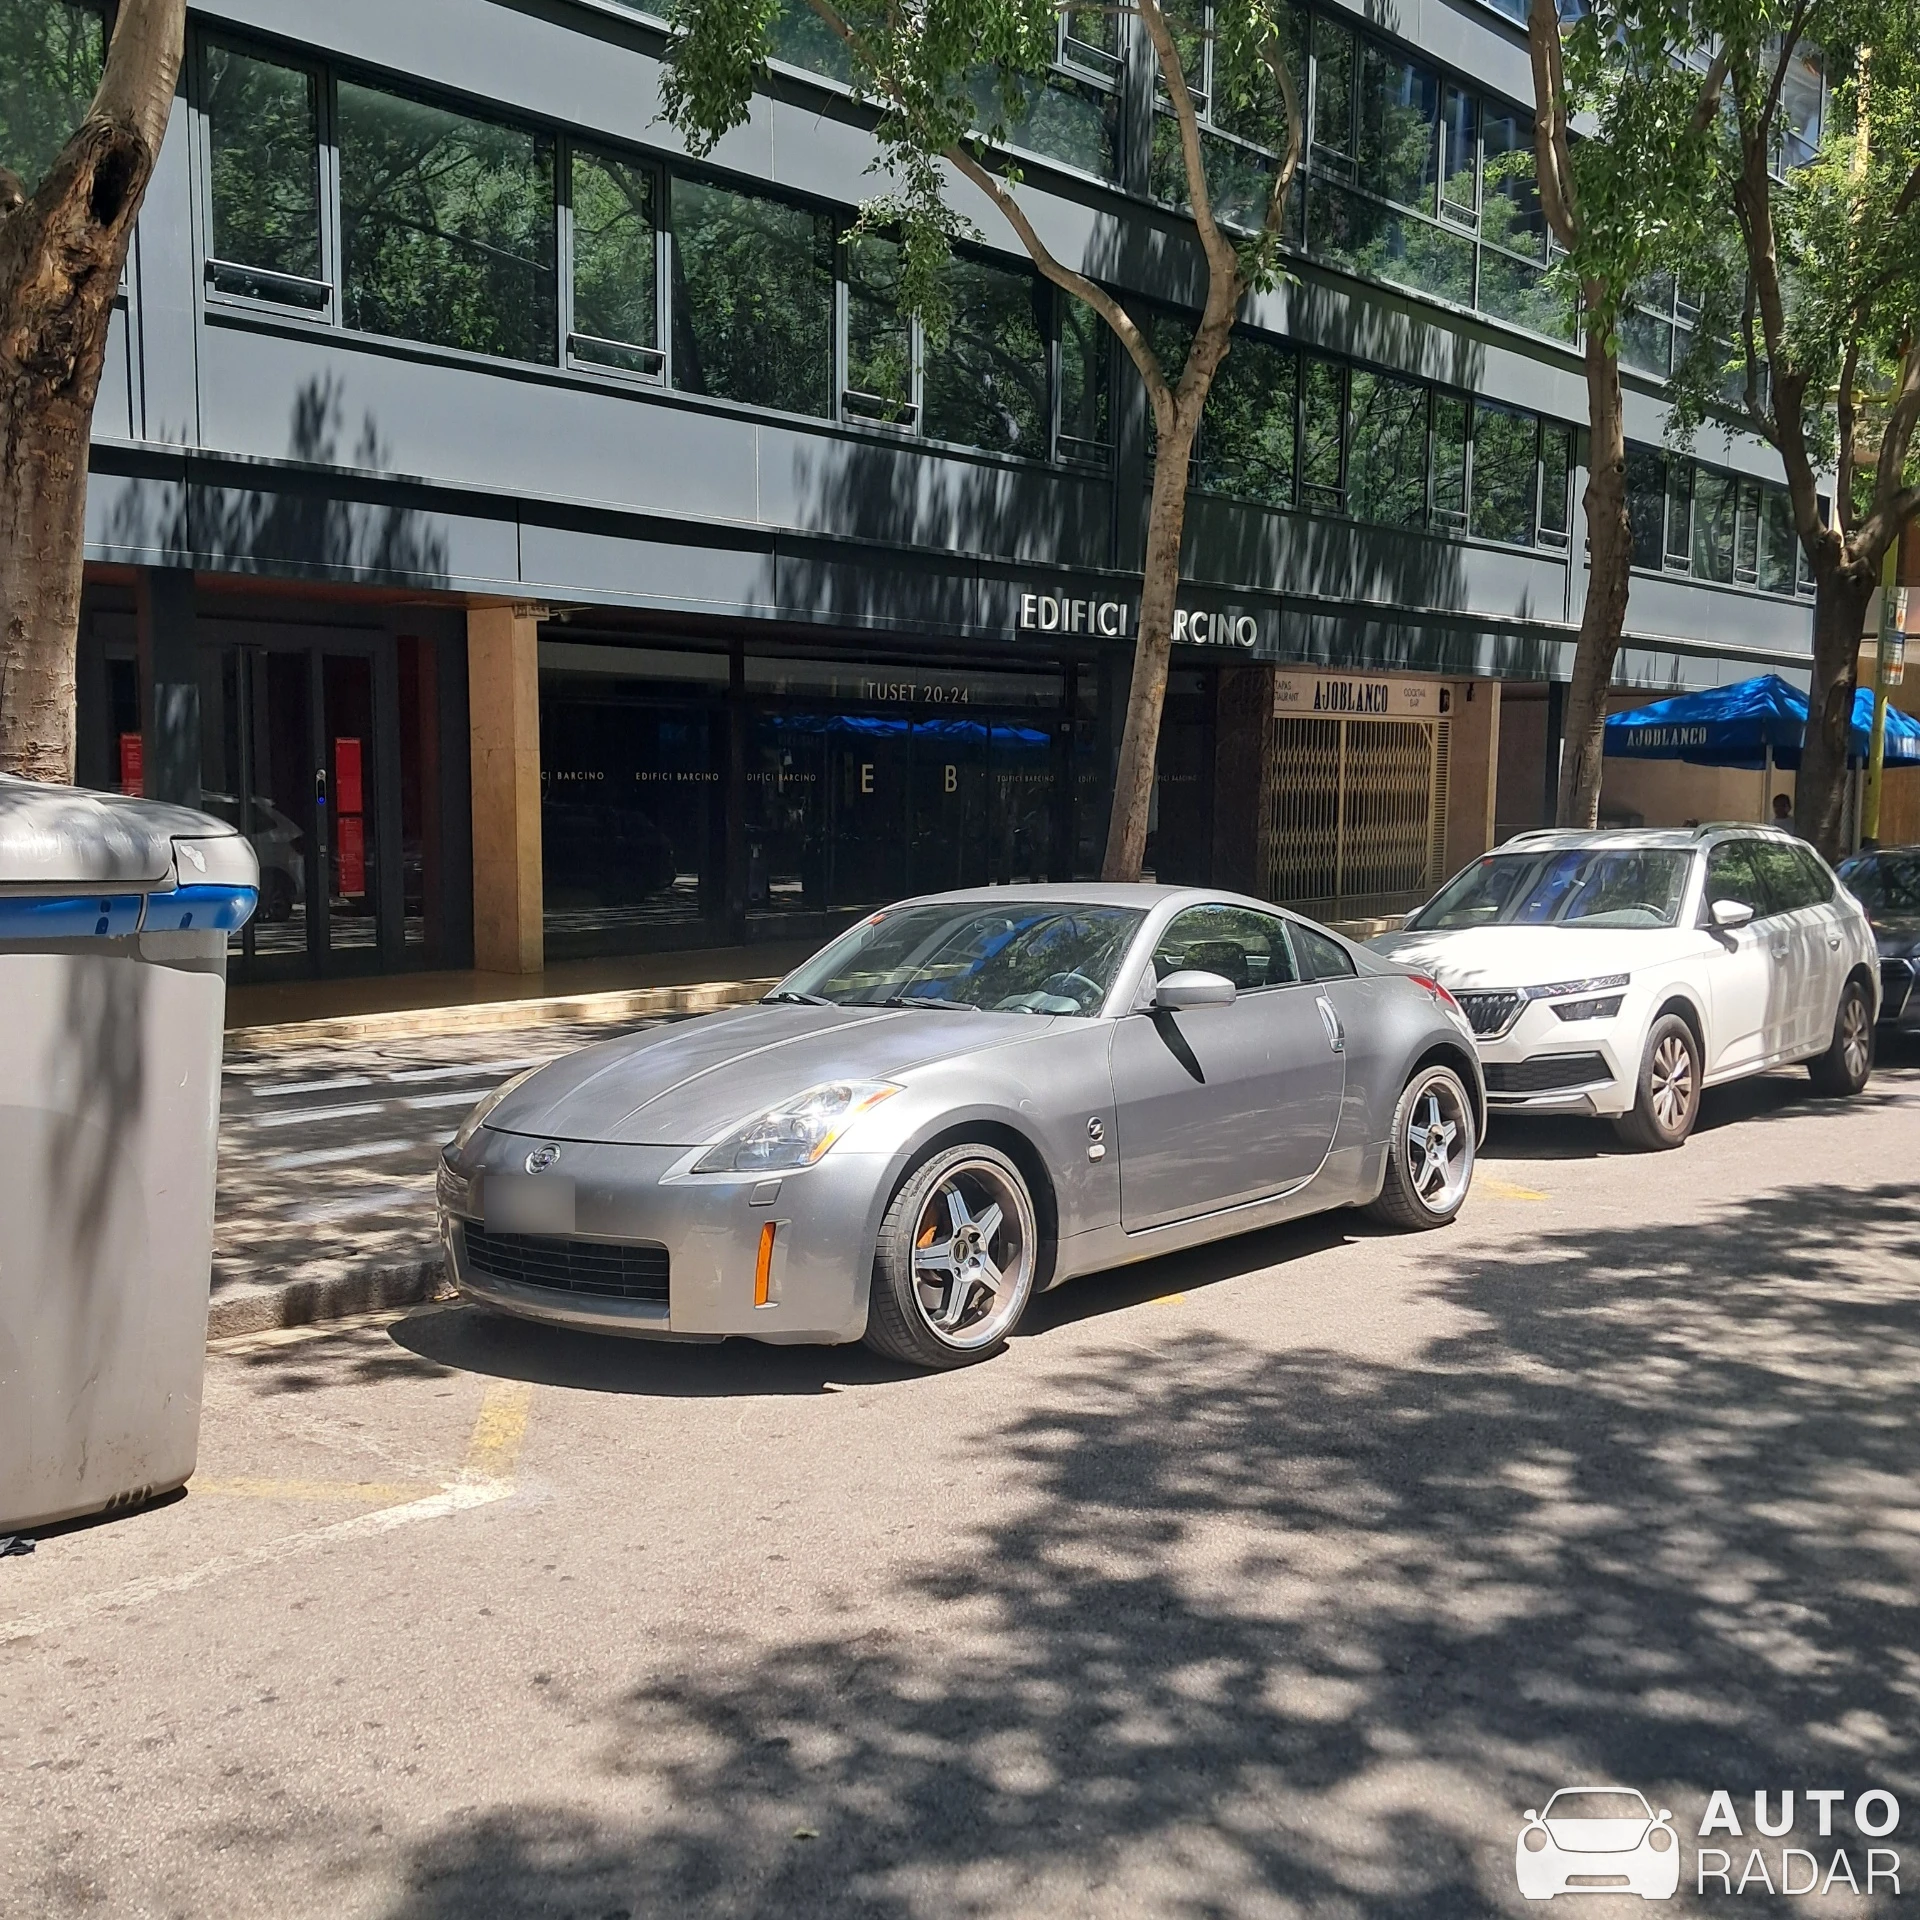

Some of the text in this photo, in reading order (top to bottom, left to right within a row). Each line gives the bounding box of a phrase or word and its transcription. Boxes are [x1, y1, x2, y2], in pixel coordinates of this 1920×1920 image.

[1020, 593, 1258, 647] EDIFICI RCINO
[866, 682, 969, 703] TUSET 20-24
[1313, 680, 1389, 713] AJOBLANCO
[1626, 727, 1707, 746] AJOBLANCO
[557, 771, 604, 780] BARCINO
[635, 772, 719, 781] EDIFICI BARCINO
[746, 773, 816, 782] DIFICI BARCINO
[861, 764, 958, 793] E B
[1024, 775, 1055, 783] BARCINO
